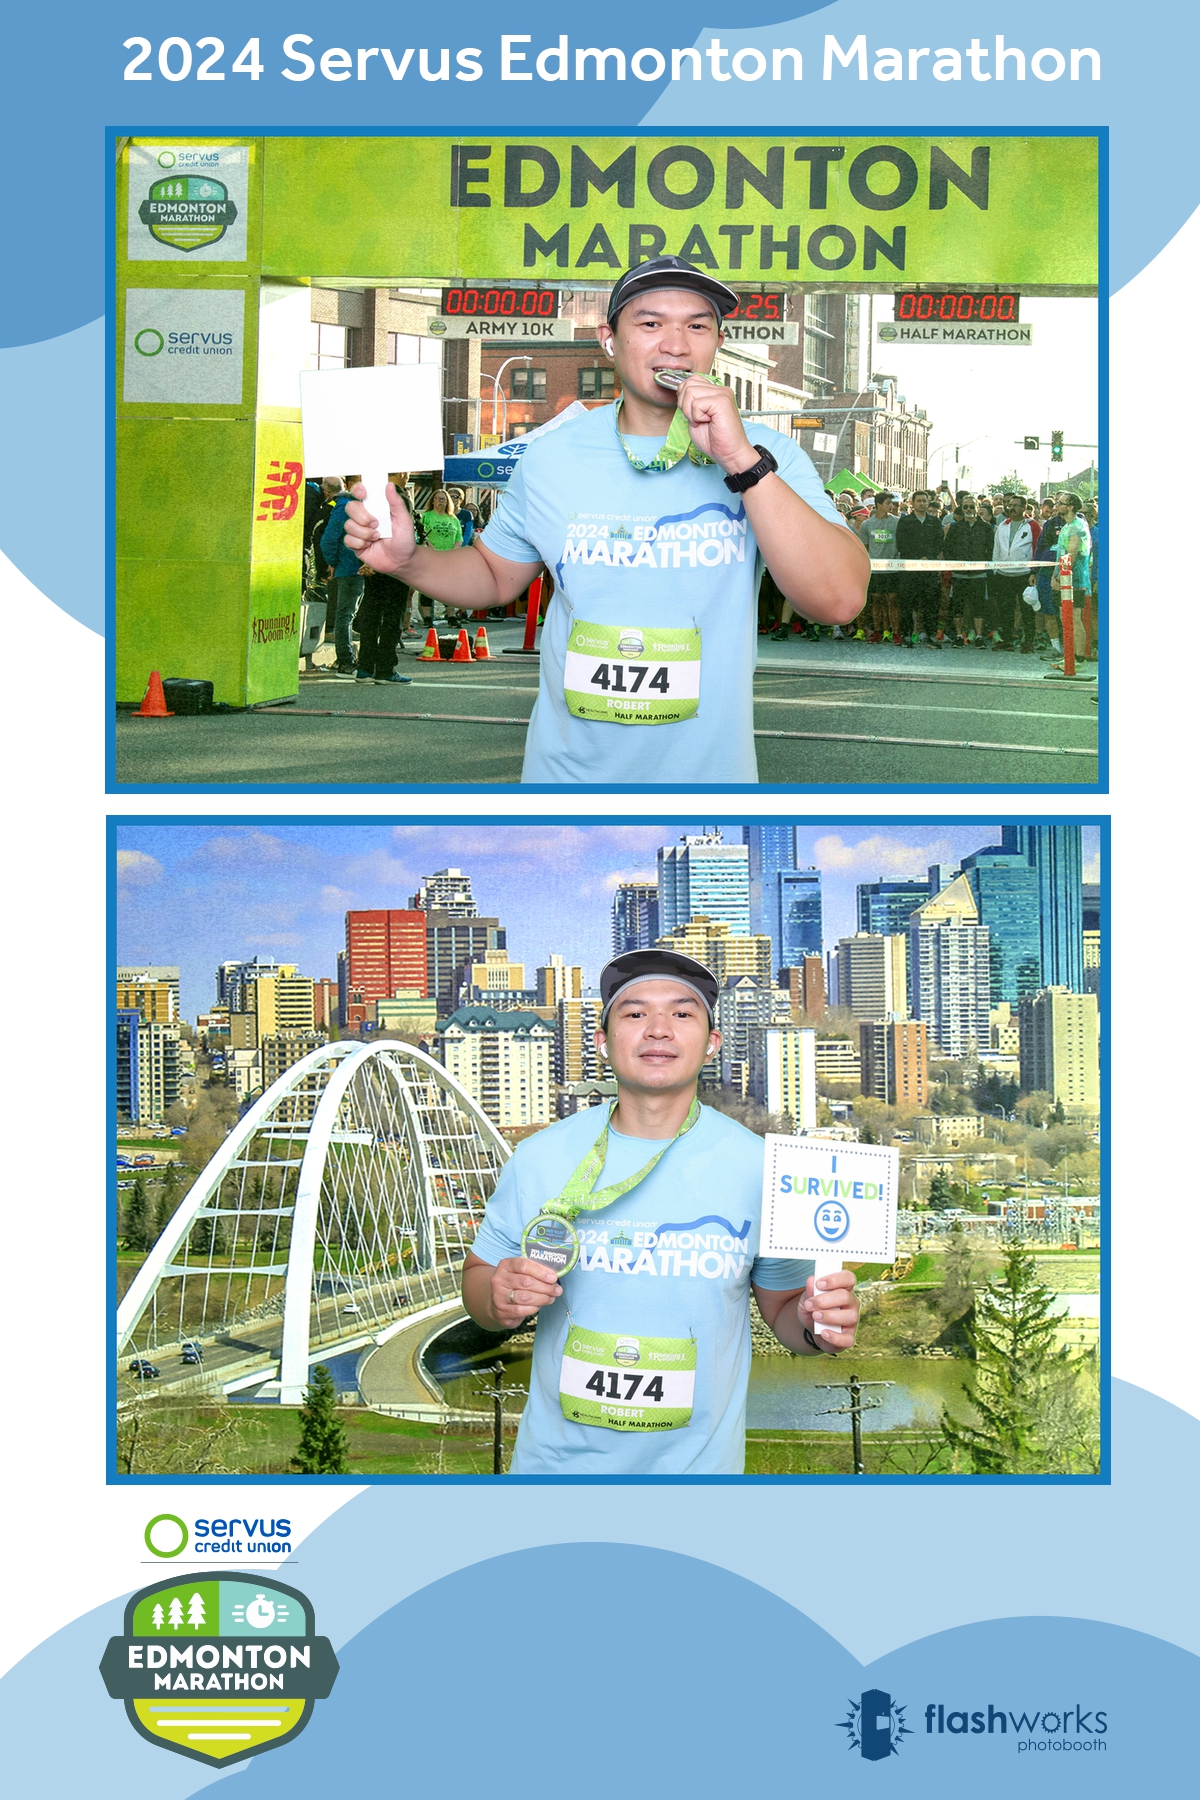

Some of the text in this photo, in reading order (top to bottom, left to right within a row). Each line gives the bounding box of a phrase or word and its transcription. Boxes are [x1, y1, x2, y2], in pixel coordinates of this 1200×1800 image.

[178, 152, 220, 161] servus
[450, 145, 990, 211] EDMONTON
[149, 203, 227, 214] EDMONTON
[160, 214, 215, 222] MARATHON
[524, 222, 906, 271] MARATHON
[466, 321, 554, 336] ARMY 10K
[900, 328, 1030, 341] HALF MARATHON
[168, 332, 233, 345] servus
[167, 345, 233, 355] credit union
[578, 512, 605, 520] servus
[607, 513, 632, 522] credit
[566, 519, 747, 542] 2024 EDMONTON
[561, 537, 746, 568] MARATHON
[258, 613, 290, 634] Running
[591, 664, 670, 693] 4174
[606, 699, 651, 711] ROBERT
[615, 712, 633, 720] HALF
[832, 1156, 836, 1173] I
[780, 1174, 883, 1201] SURVIVED!
[577, 1218, 605, 1226] servus
[607, 1219, 632, 1227] credit
[633, 1231, 748, 1254] EDMONTON
[586, 1370, 664, 1402] 4174
[601, 1405, 644, 1418] ROBERT
[608, 1418, 673, 1428] HALF MARATHON
